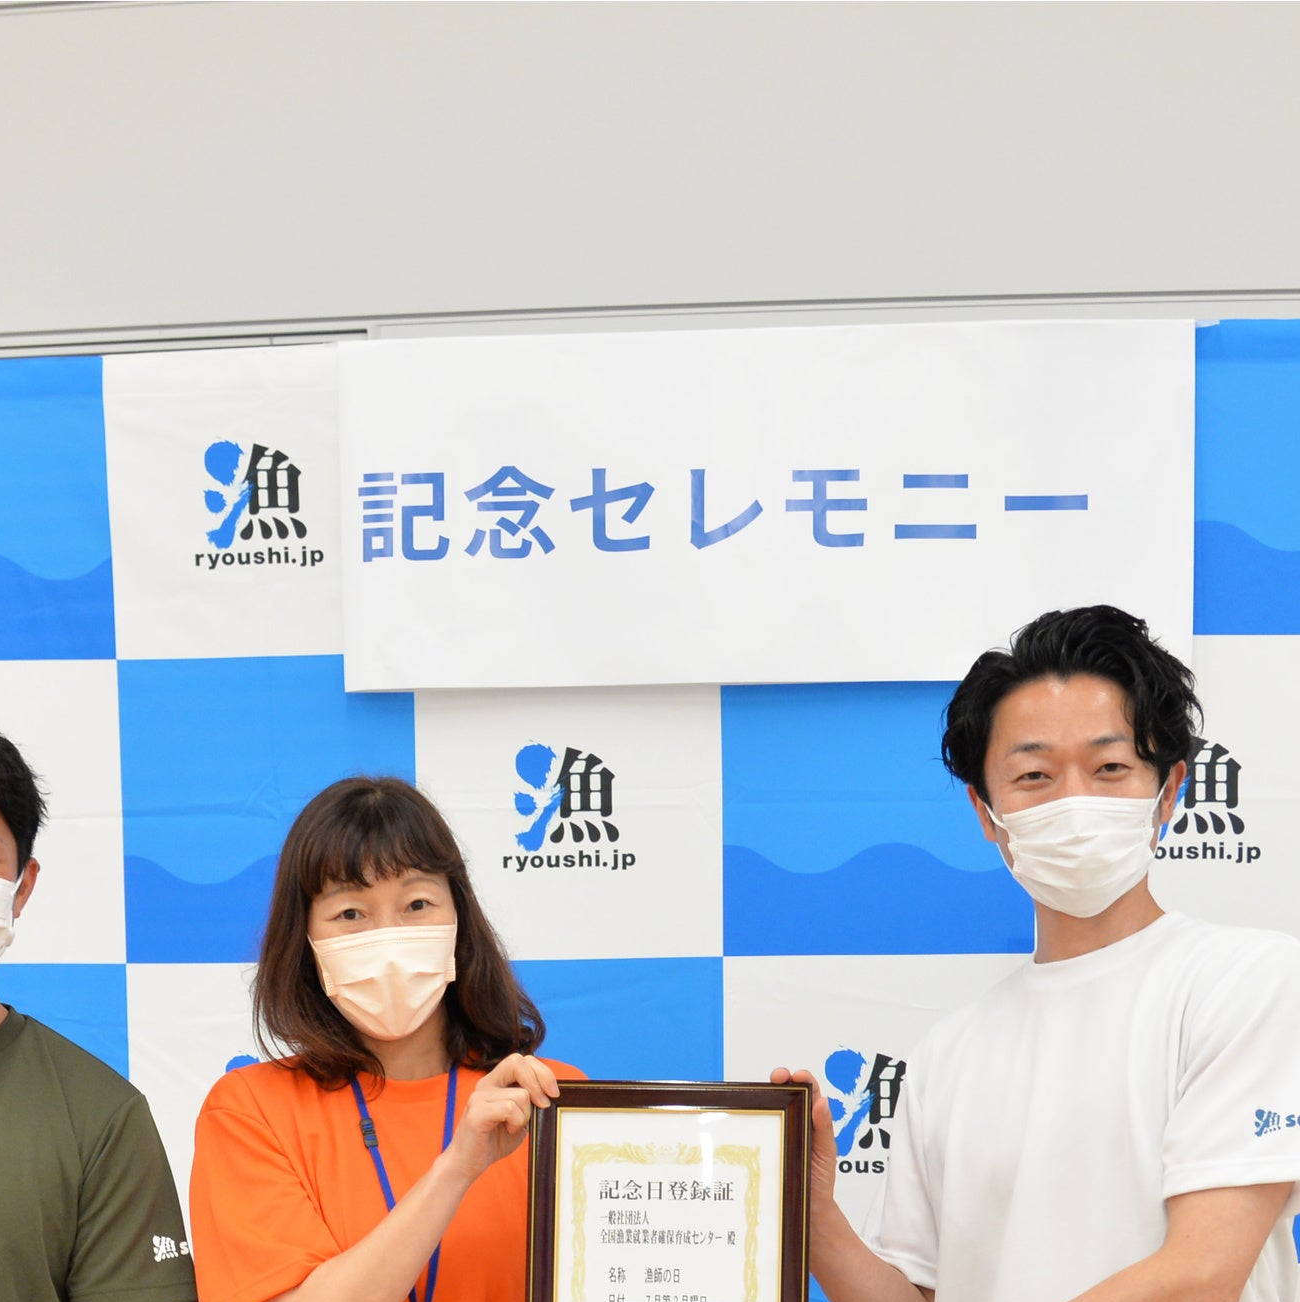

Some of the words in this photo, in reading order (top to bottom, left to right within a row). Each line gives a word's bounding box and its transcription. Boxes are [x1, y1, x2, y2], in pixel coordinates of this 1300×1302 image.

[358, 465, 1089, 563] 記念セレモニー
[194, 546, 324, 570] ryoushi.jp
[503, 849, 636, 872] ryoushi.jp
[838, 1157, 889, 1174] ous
[599, 1179, 734, 1202] 記念日登録証
[600, 1210, 650, 1225] 一般社団法人
[609, 1267, 626, 1283] 名称
[644, 1268, 680, 1284] 漁師の日
